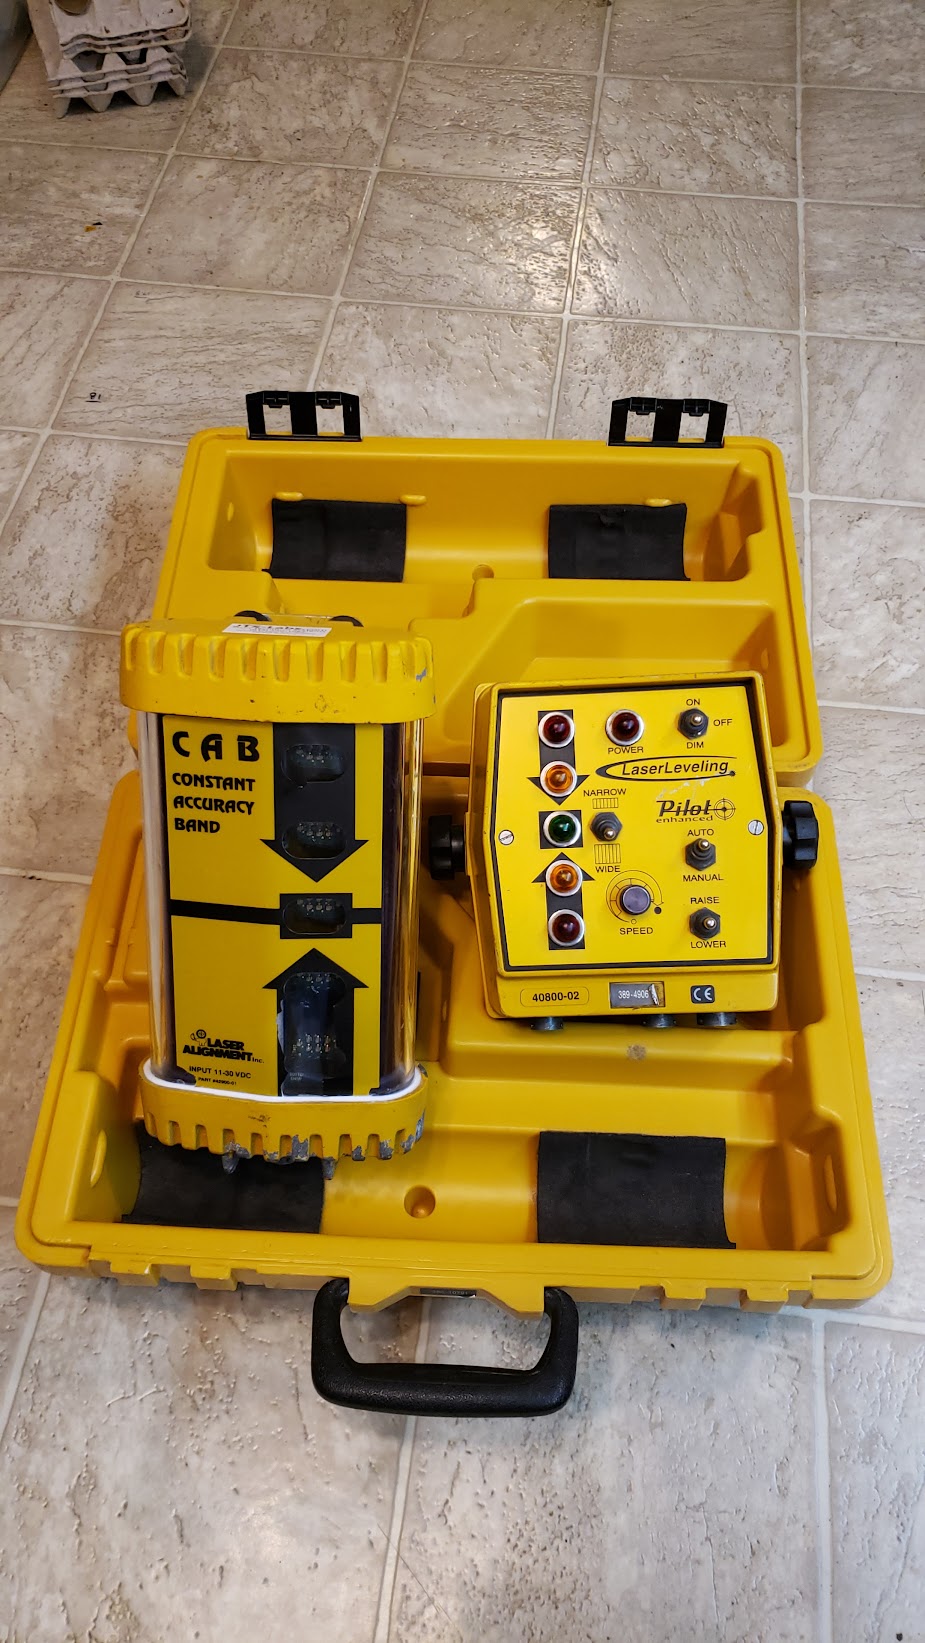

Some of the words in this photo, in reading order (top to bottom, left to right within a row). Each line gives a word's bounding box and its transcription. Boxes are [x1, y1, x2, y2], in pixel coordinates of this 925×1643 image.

[686, 741, 704, 749] DIM
[607, 746, 644, 755] POWER
[622, 760, 729, 776] LaserLeveling
[172, 772, 256, 792] CONSTANT
[583, 788, 627, 797] NARROW
[173, 795, 255, 815] ACCURACY
[656, 799, 712, 817] Pilot
[656, 815, 713, 823] enhanced
[174, 818, 220, 833] BAND
[687, 829, 714, 837] AUTO
[595, 865, 621, 873] WIDE
[682, 874, 724, 882] MANUAL
[619, 927, 653, 935] SPEED
[690, 941, 727, 949] LOWER
[532, 991, 580, 1002] 40800-02
[617, 990, 649, 999] 389-4906
[693, 987, 712, 1000] CE
[207, 1038, 245, 1051] LASER
[182, 1045, 253, 1061] ALIGNMENT
[189, 1066, 212, 1074] INPUT
[214, 1069, 234, 1077] 11-30
[235, 1071, 252, 1079] VDC
